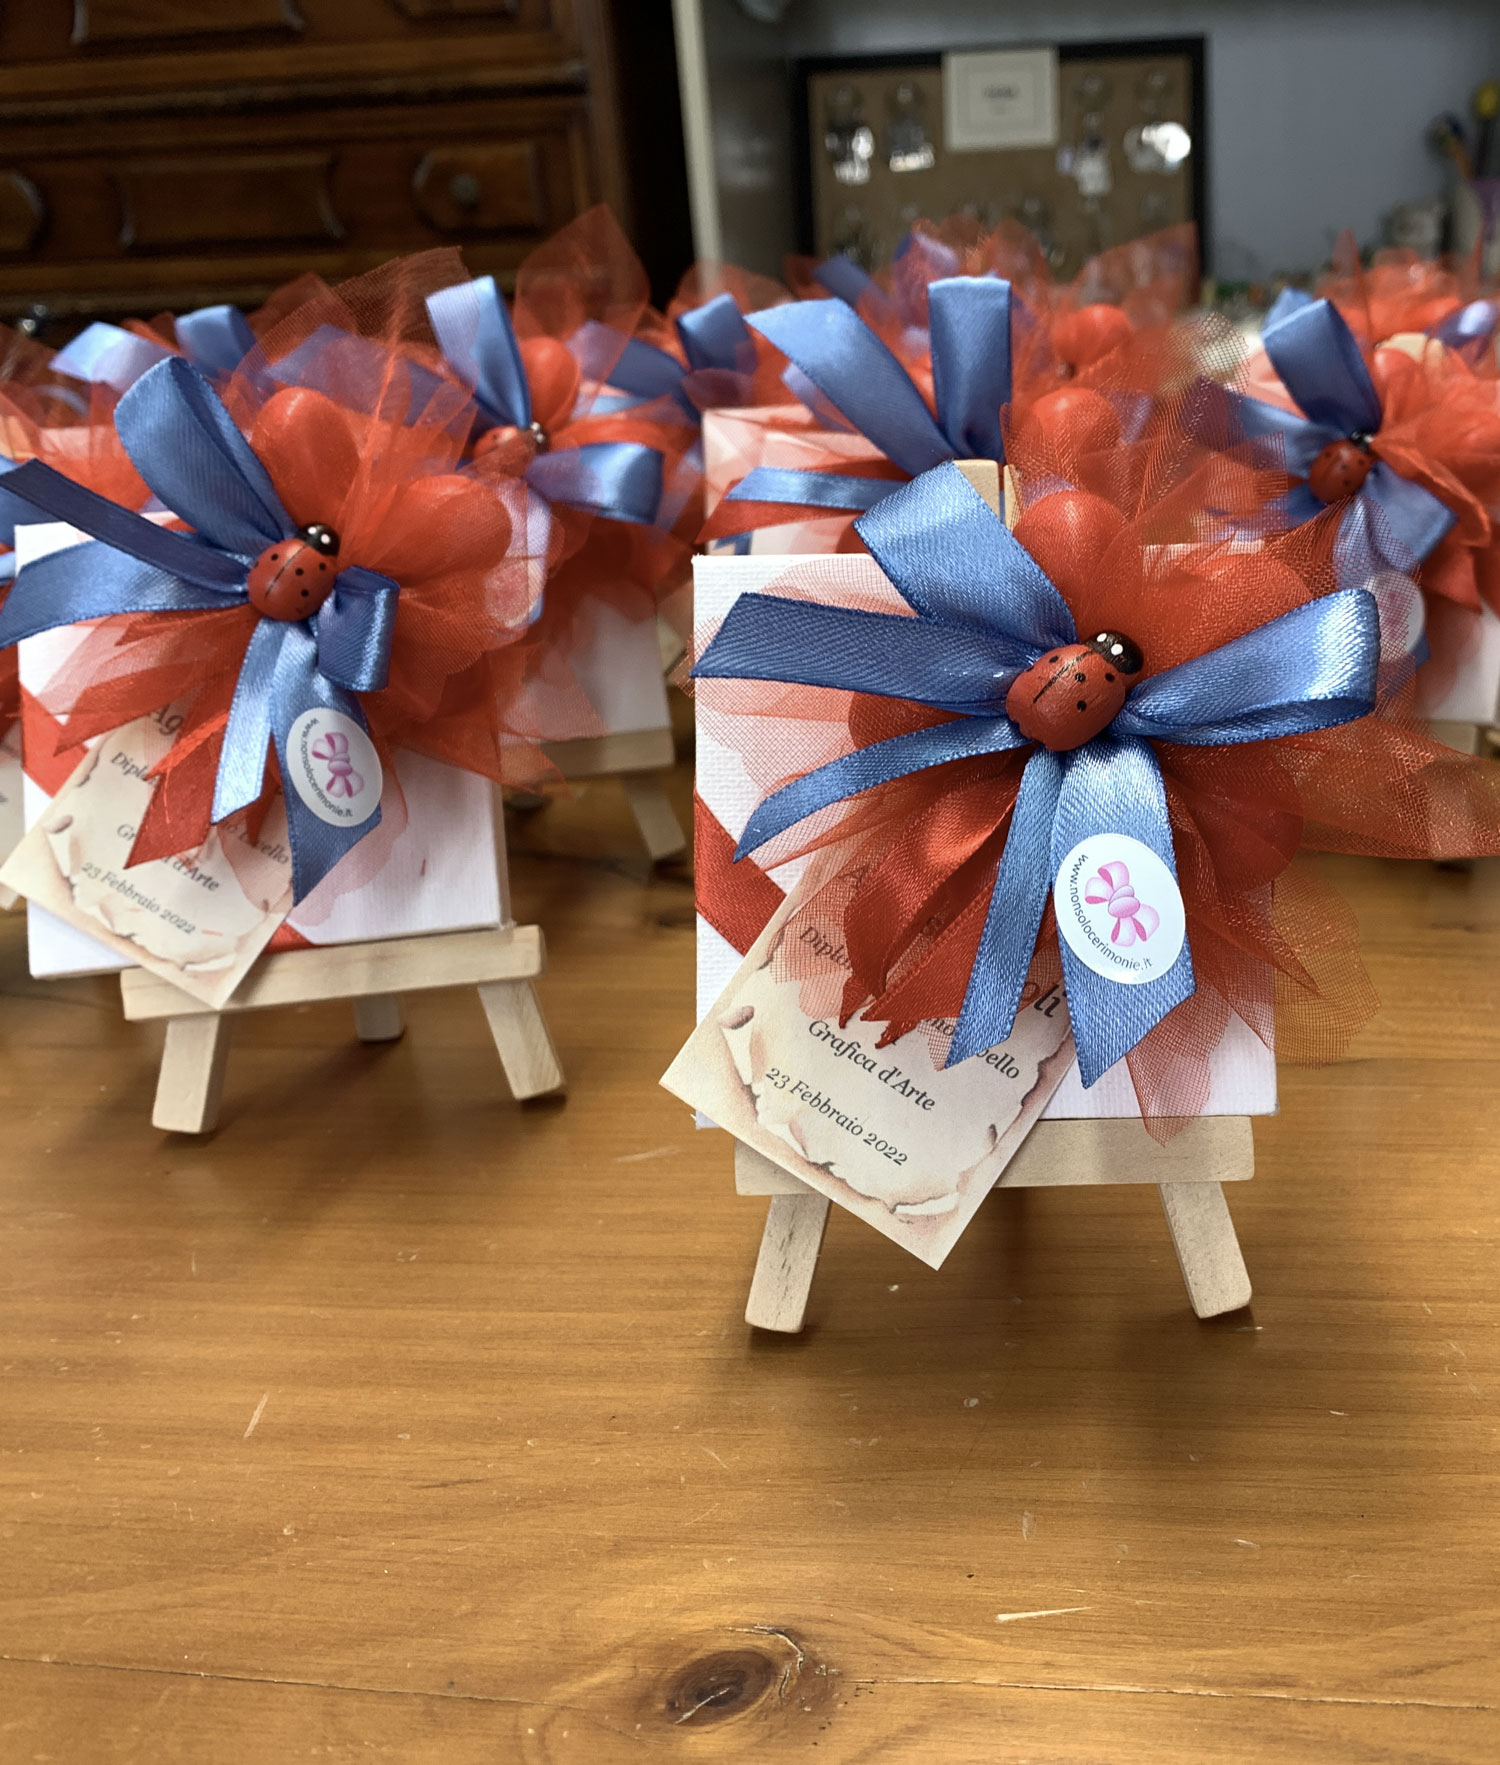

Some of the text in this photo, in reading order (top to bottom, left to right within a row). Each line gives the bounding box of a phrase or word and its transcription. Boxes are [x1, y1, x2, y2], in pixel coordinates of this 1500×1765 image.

[81, 861, 197, 935] 23 Febbraio 2022
[1069, 853, 1153, 971] www.nonsolocerimonie.it
[808, 1020, 936, 1112] Grafica d'Arte
[765, 1067, 909, 1166] 23 Febbraio 2022
